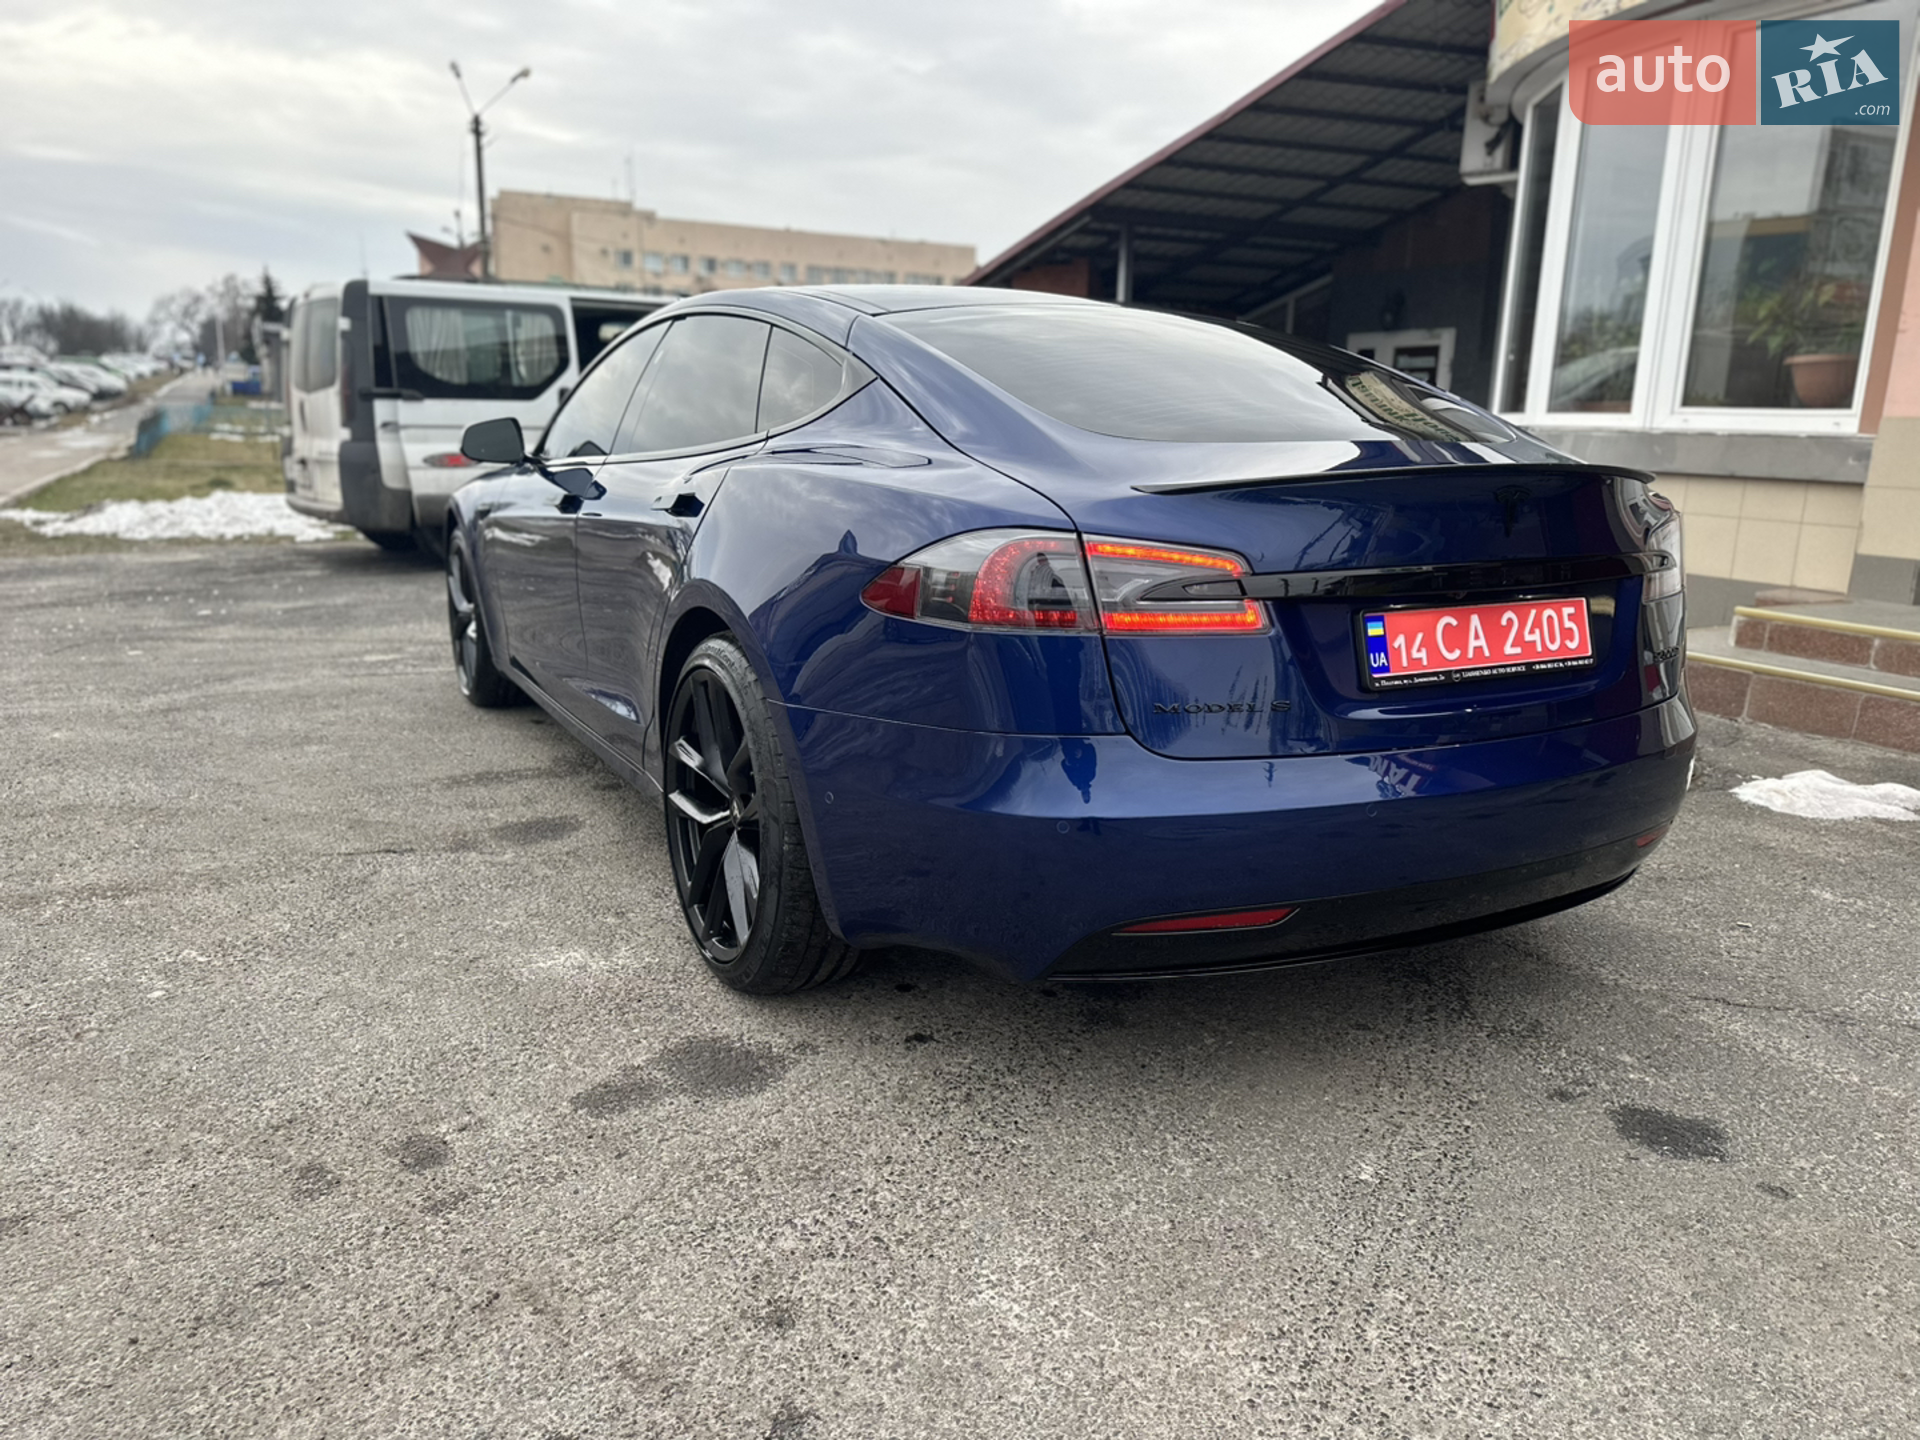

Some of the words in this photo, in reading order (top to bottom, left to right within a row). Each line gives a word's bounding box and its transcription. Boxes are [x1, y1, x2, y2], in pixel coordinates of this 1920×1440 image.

[1392, 632, 1428, 668] 14
[1435, 613, 1490, 661] CA
[1500, 607, 1580, 656] 2405
[1370, 652, 1388, 668] UA
[1153, 702, 1263, 714] MODEL
[1270, 700, 1291, 712] S
